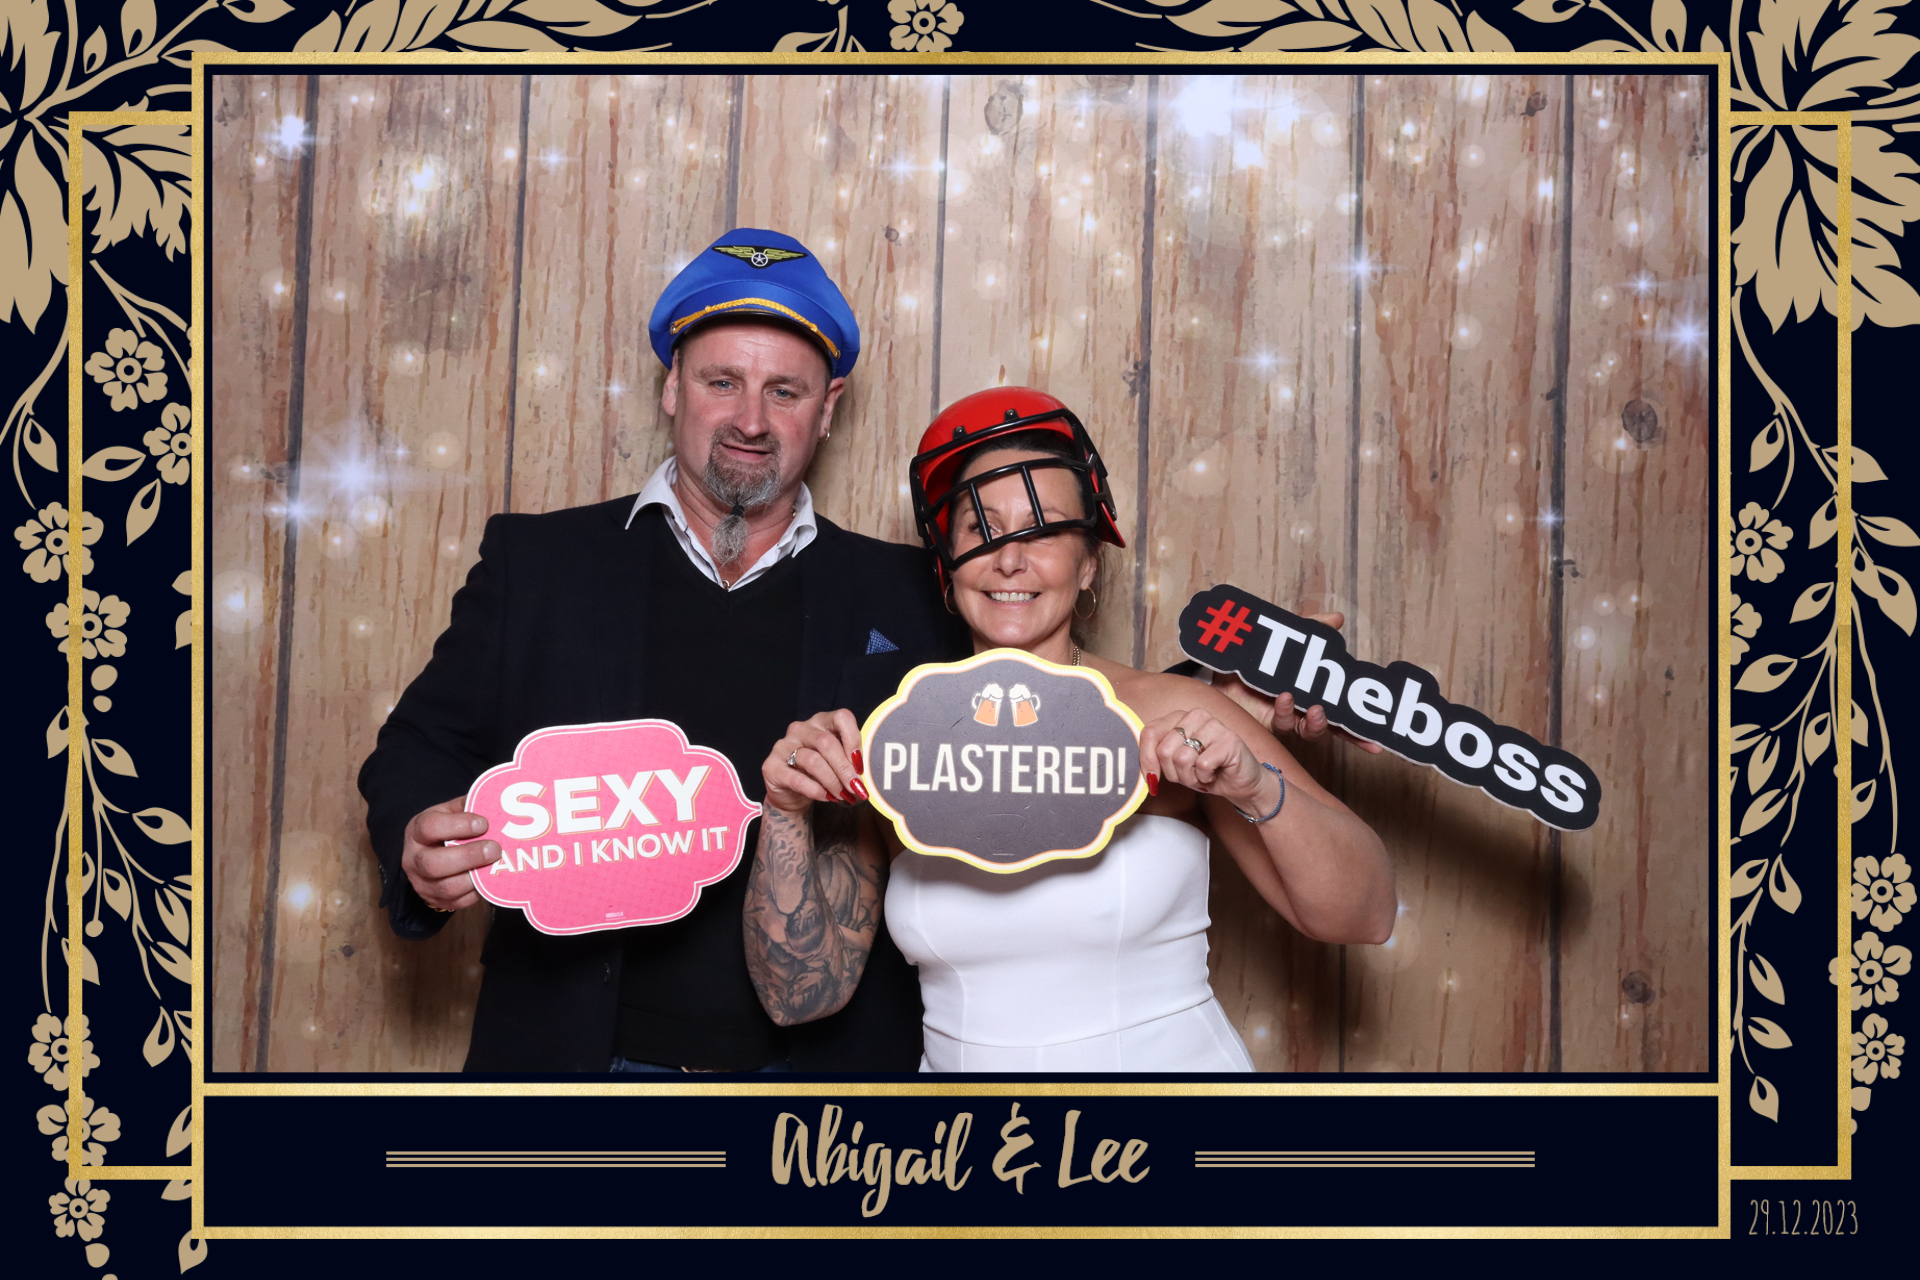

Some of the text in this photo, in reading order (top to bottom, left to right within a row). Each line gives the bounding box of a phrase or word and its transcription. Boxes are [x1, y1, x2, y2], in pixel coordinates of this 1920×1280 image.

[1197, 599, 1588, 814] #Theboss
[883, 742, 1127, 795] PLASTERED!
[500, 765, 712, 840] SEXY
[489, 825, 731, 875] AND I KNOW IT
